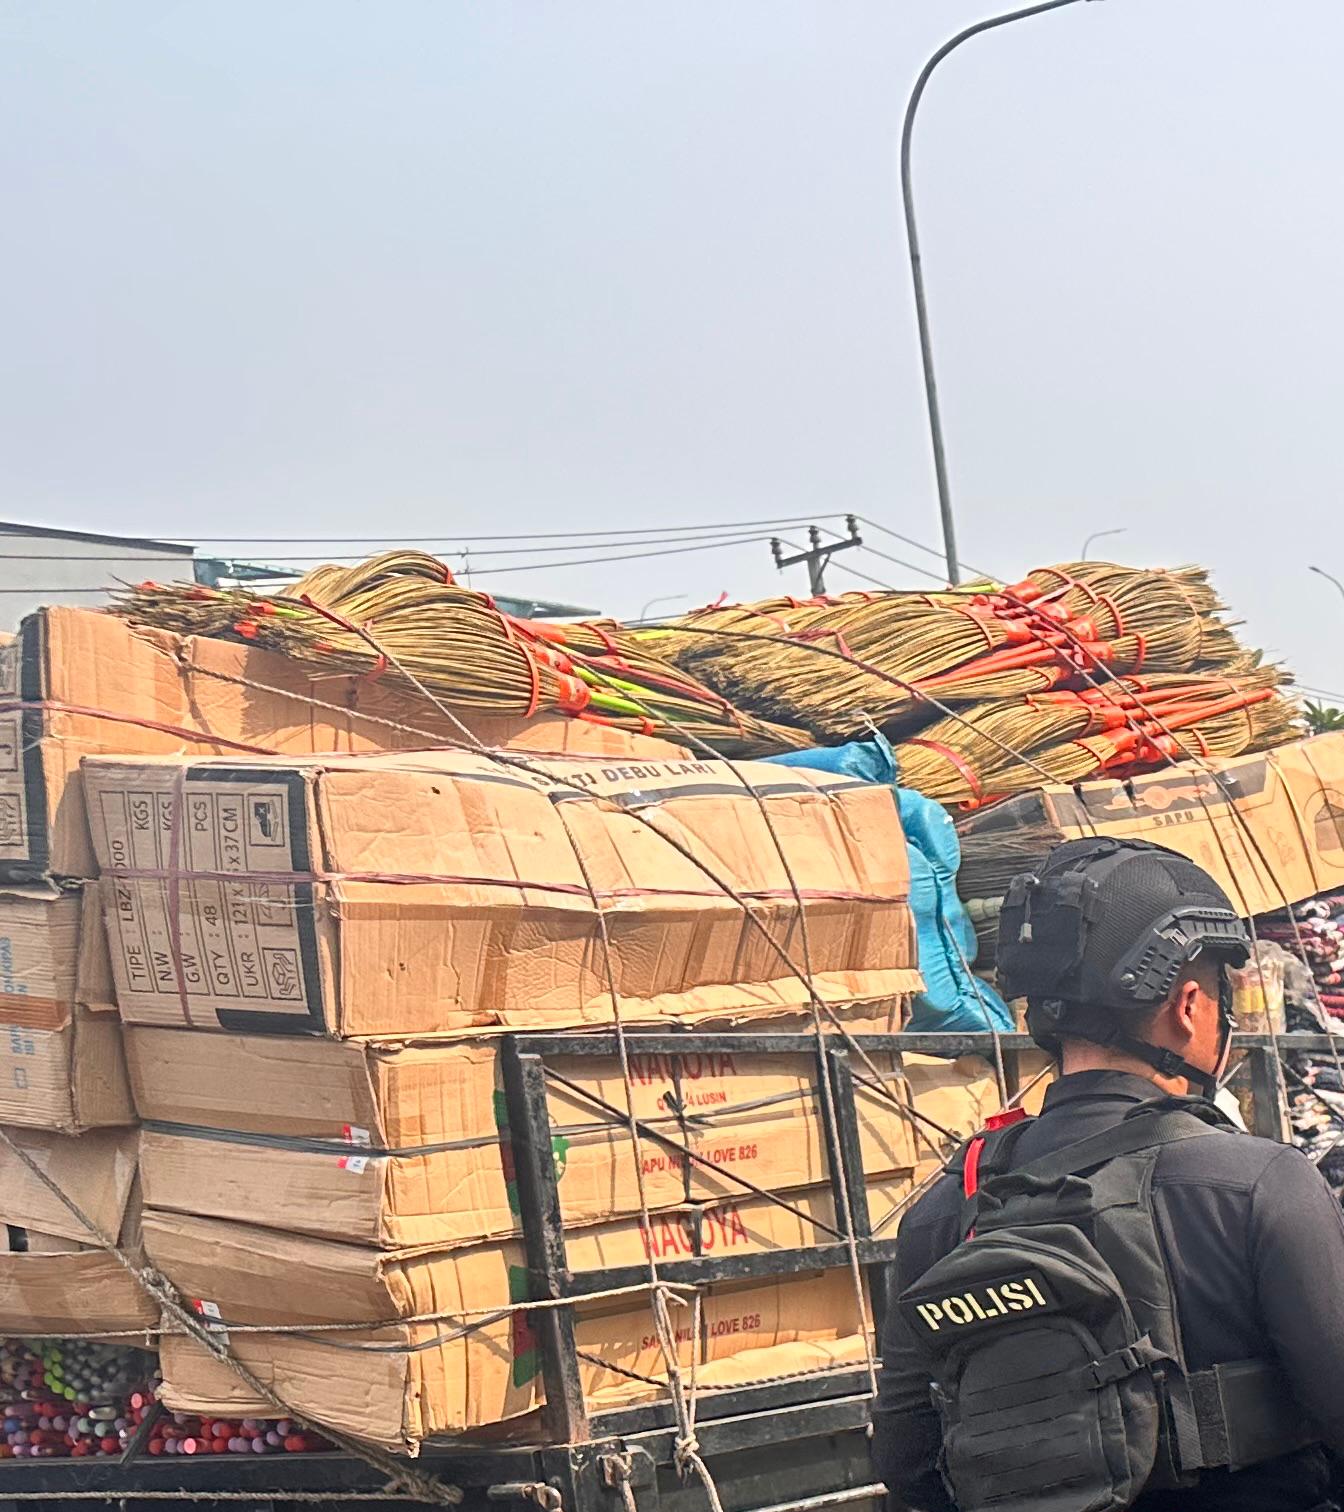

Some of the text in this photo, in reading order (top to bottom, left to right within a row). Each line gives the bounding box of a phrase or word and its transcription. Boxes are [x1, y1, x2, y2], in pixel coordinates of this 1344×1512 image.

[600, 762, 662, 783] DEBU
[663, 762, 718, 776] LARI
[133, 800, 149, 831] KGS
[1152, 810, 1195, 827] SAPU
[193, 800, 231, 985] QTY 48 PCS
[232, 901, 248, 925] 121
[126, 944, 145, 980] TIPE
[240, 951, 260, 987] UKR
[629, 1053, 737, 1087] NAOYA
[697, 1090, 727, 1105] LUSIN
[641, 1157, 665, 1175] APU
[708, 1148, 736, 1165] LOVE
[738, 1144, 758, 1160] 826
[916, 1278, 1047, 1331] POLISI
[711, 1317, 740, 1336] LOVE
[742, 1313, 761, 1331] 826
